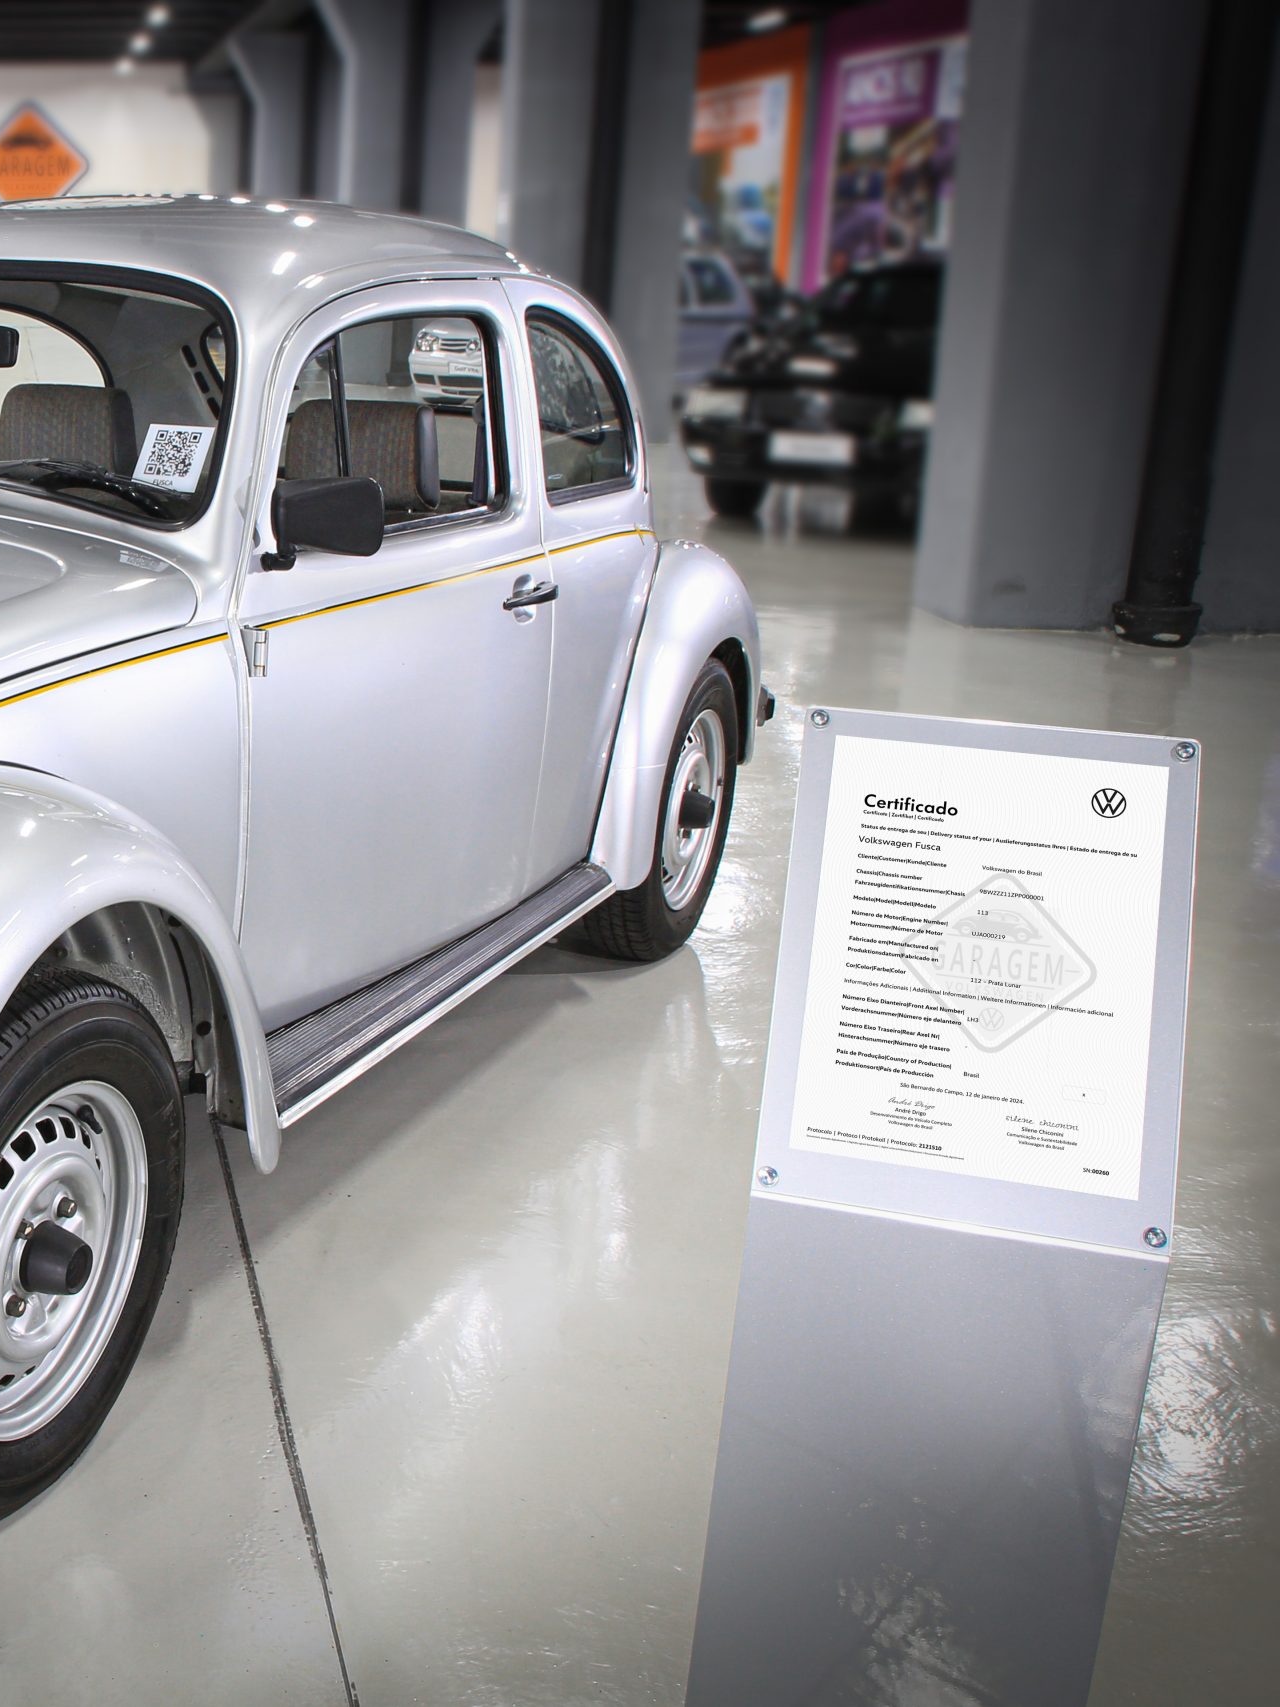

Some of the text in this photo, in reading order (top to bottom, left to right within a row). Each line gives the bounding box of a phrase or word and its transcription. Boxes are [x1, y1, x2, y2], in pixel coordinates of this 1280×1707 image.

[864, 794, 958, 817] Certificado
[917, 815, 945, 823] Certificado
[858, 835, 941, 852] Volkswagen Fusca
[930, 830, 953, 839] Delivery
[995, 838, 1051, 849] Auslieferungsstatus
[1069, 845, 1090, 853] Estado
[1098, 849, 1121, 857] entrega
[982, 865, 1017, 874] Volkswagen
[851, 910, 875, 918] Número
[848, 935, 878, 944] Fabricado
[931, 940, 1065, 986] GARAGEM
[987, 979, 1004, 987] Prata
[945, 981, 1044, 1002] VOLKSWAGEN
[842, 993, 866, 1002] Número
[866, 996, 880, 1004] Eixo
[879, 982, 909, 991] Adicionais
[912, 986, 942, 995] Additional
[942, 990, 977, 1000] Information
[980, 995, 1004, 1004] Weitere
[1004, 998, 1047, 1008] Informationen
[1050, 1004, 1086, 1014] Información
[1087, 1009, 1114, 1018] adicional
[839, 1021, 863, 1029] Número
[933, 1017, 962, 1026] delantero
[901, 1068, 934, 1078] Producción
[963, 1071, 980, 1079] Brasil
[910, 1083, 936, 1092] Bernardo
[1009, 1097, 1025, 1105] 2024.
[912, 1109, 927, 1117] Drigo
[1021, 1126, 1064, 1137] Silene Chiconini
[807, 1126, 833, 1135] Protocolo
[861, 1134, 886, 1143] Protokoll
[890, 1139, 918, 1148] Protocolo:
